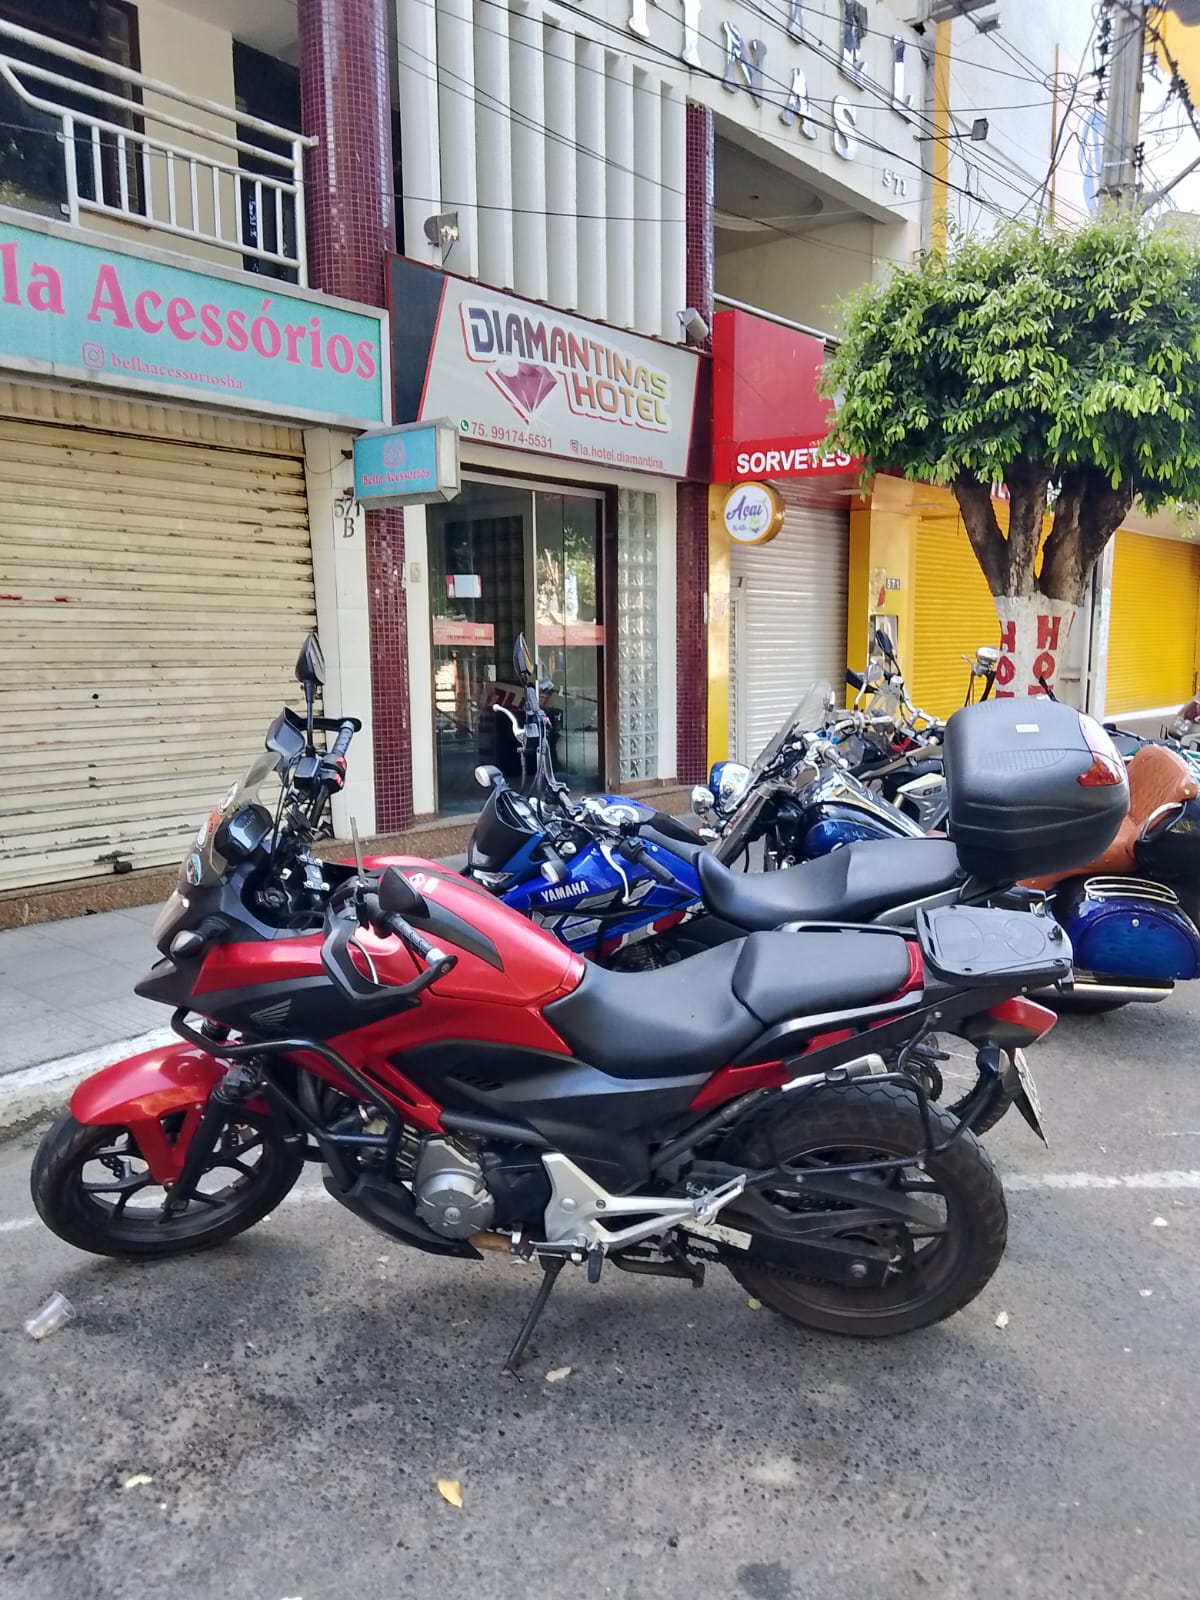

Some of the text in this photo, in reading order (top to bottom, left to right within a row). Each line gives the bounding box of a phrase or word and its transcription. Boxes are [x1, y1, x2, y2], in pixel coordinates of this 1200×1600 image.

[882, 167, 907, 196] 571
[87, 262, 376, 380] Acessórios
[468, 307, 668, 400] DIAMANTINAS
[111, 352, 244, 390] bellaacessoriosha
[572, 371, 668, 425] HOTEL
[491, 425, 553, 449] 99174-5531
[736, 447, 850, 475] SORVETES
[334, 498, 360, 518] 571
[343, 517, 355, 538] B
[541, 880, 590, 903] YAMAHA
